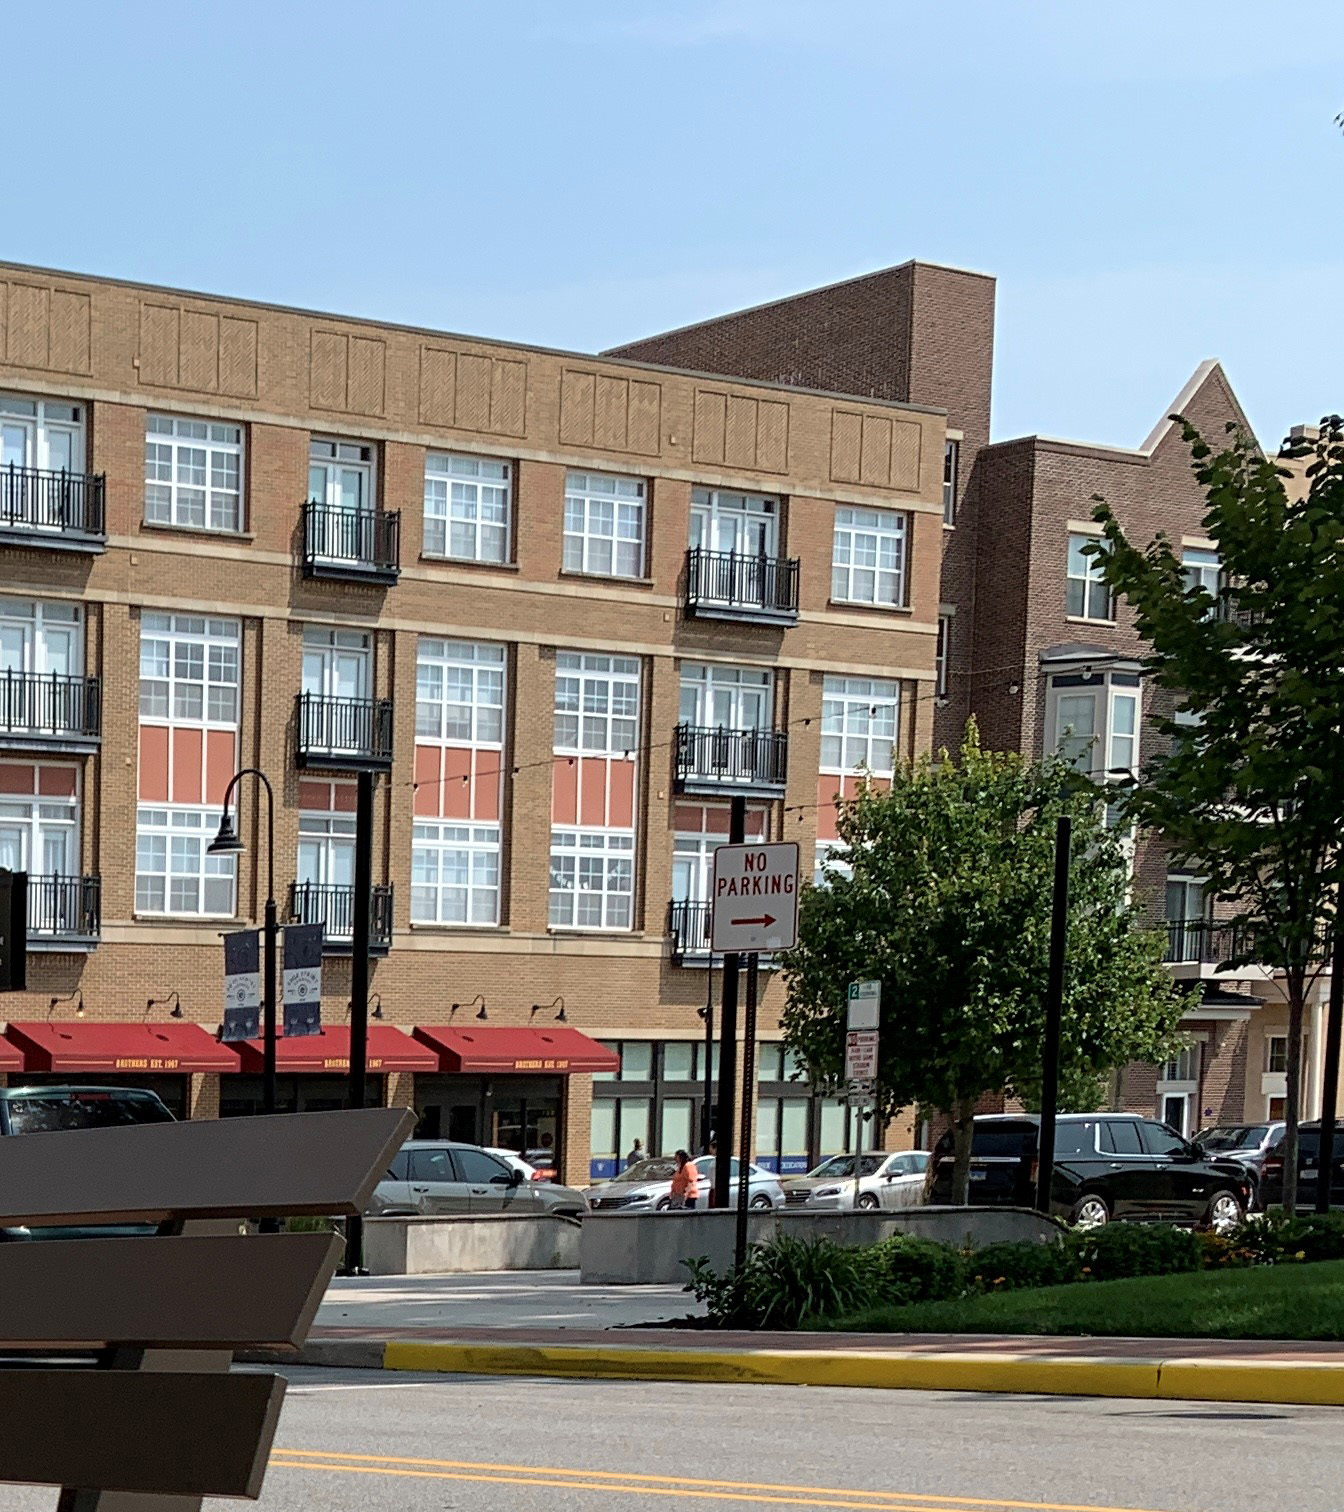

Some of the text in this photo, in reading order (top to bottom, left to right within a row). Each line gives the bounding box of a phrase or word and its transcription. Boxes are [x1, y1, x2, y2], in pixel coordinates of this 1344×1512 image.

[744, 852, 767, 873] NO
[717, 874, 794, 897] PARKING
[852, 986, 859, 997] 2
[116, 1059, 148, 1069] BROTHERS
